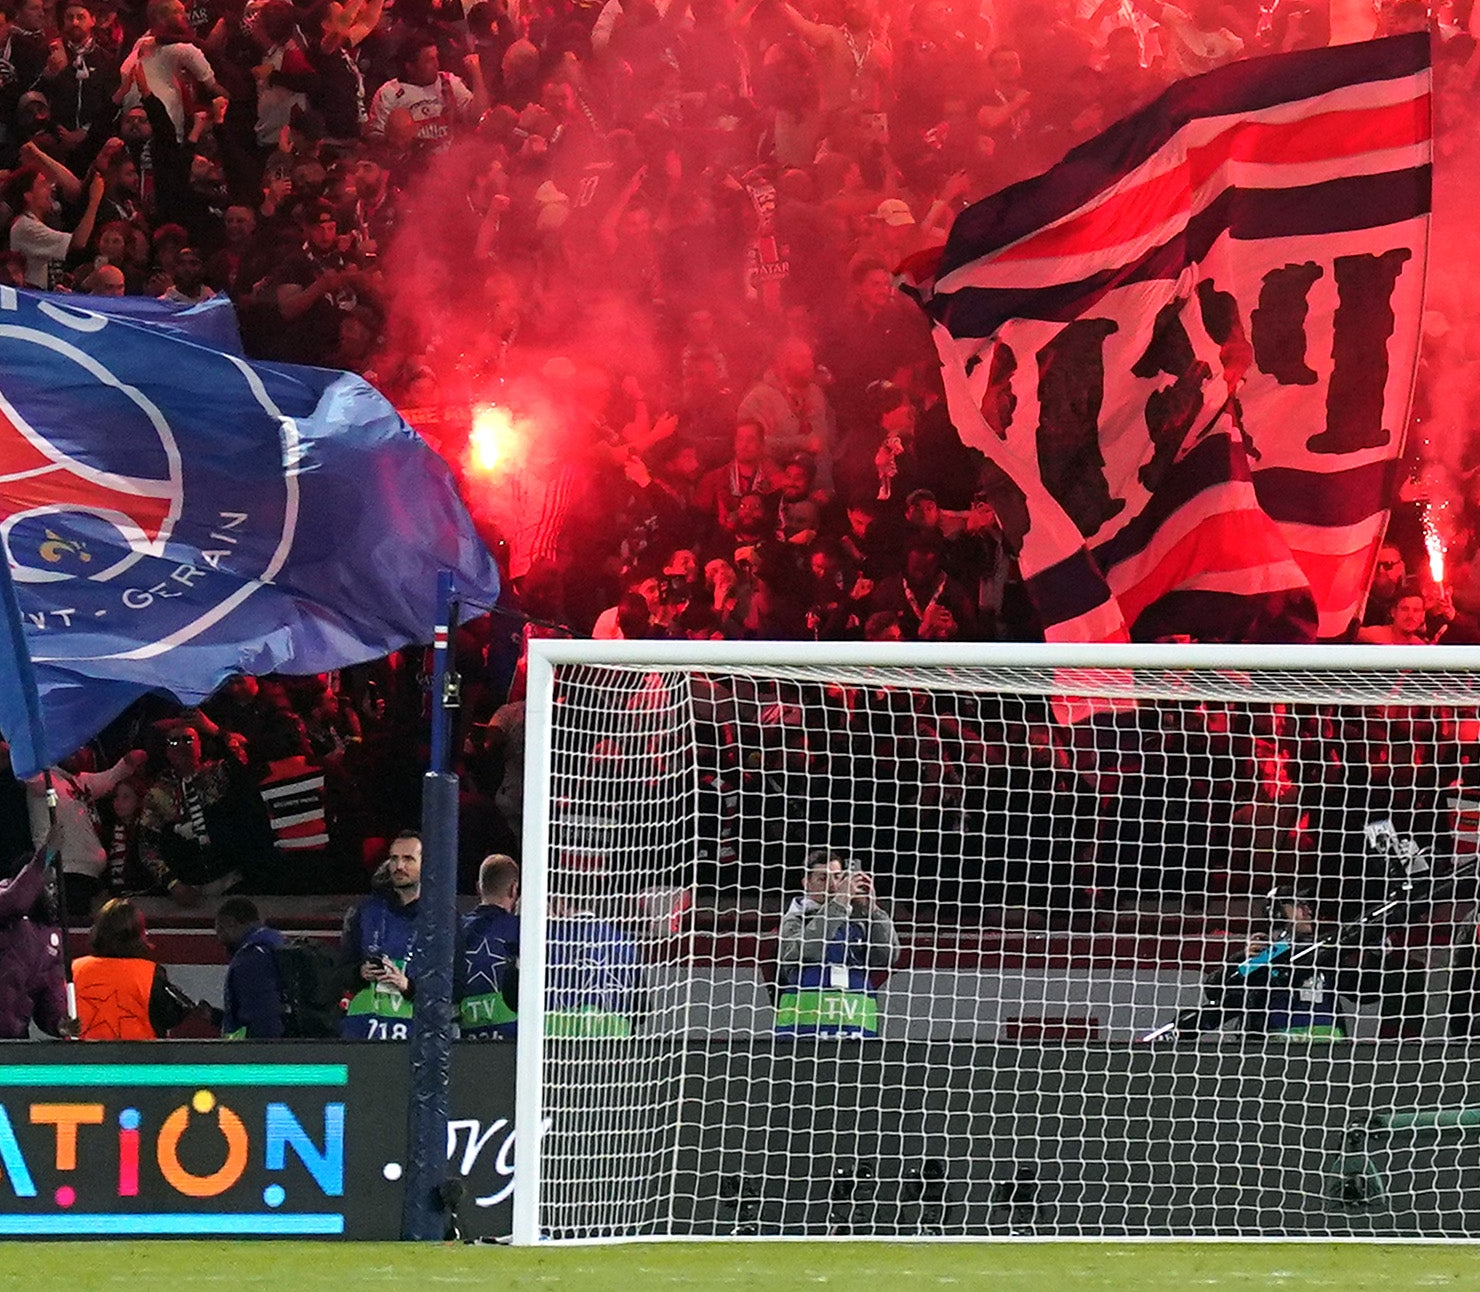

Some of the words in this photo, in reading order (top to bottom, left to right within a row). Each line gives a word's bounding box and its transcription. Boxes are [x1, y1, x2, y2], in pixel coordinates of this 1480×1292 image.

[120, 509, 249, 610] GERMAIN
[468, 1000, 496, 1022] TV
[824, 998, 858, 1020] TV
